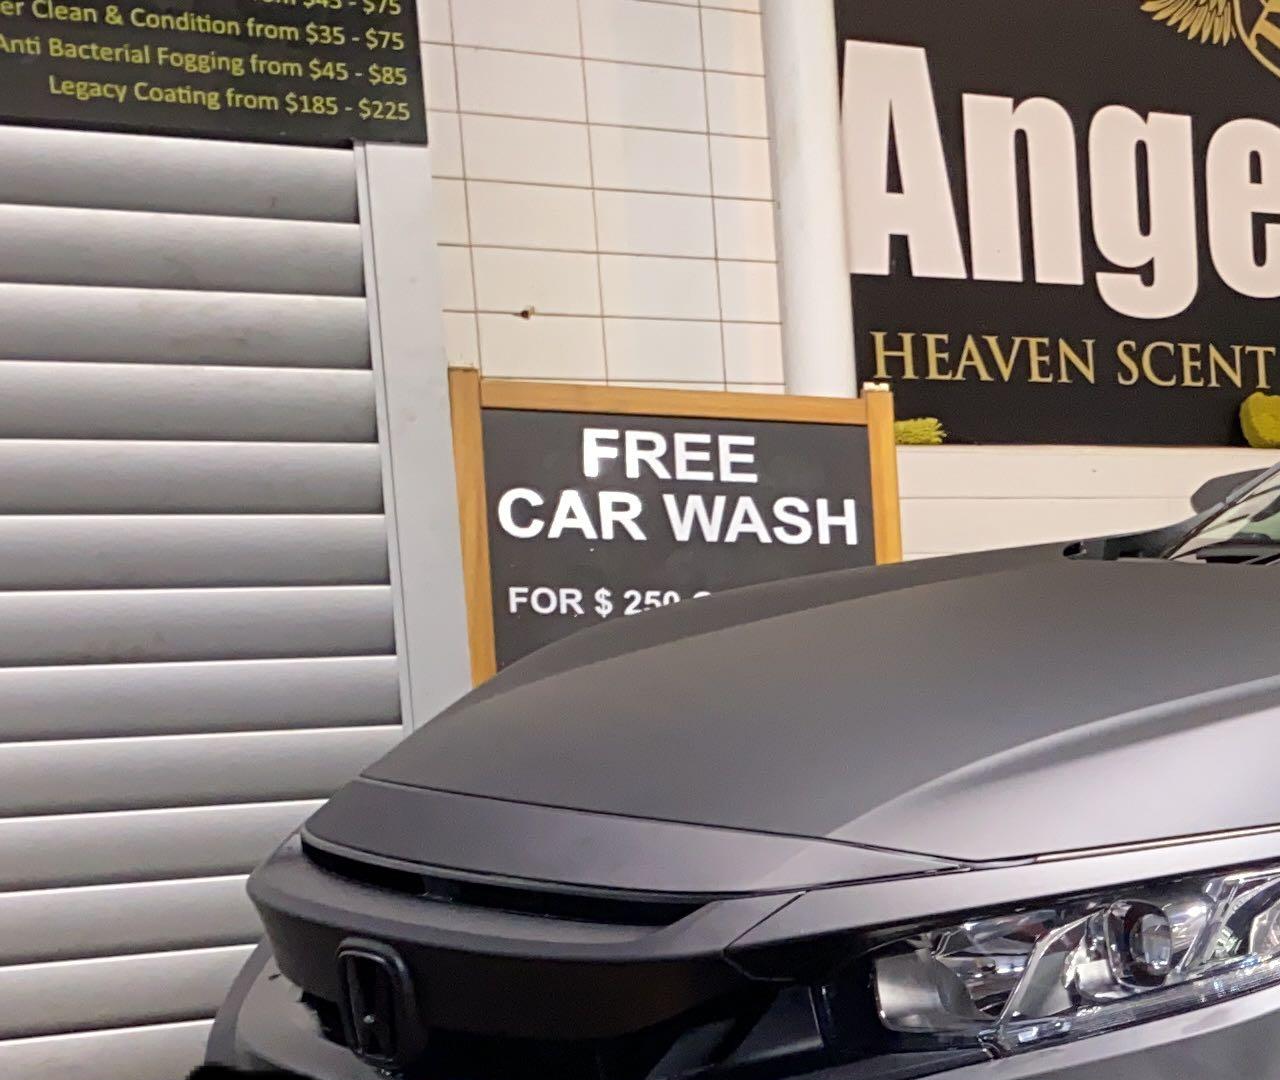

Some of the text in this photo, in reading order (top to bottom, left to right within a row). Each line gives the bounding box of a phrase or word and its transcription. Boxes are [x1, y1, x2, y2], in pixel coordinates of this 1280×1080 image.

[32, 0, 98, 23] Clean
[105, 5, 125, 25] &
[130, 8, 241, 36] Condition
[247, 17, 300, 41] from
[305, 22, 346, 46] $35
[365, 27, 405, 50] $75
[0, 33, 41, 55] Anti
[48, 37, 151, 65] Bacterial
[157, 47, 245, 77] Fogging
[250, 54, 303, 77] from
[309, 57, 349, 82] $45
[368, 63, 408, 86] $85
[48, 75, 127, 102] Legacy
[134, 81, 221, 111] Coating
[226, 88, 279, 111] from
[285, 91, 339, 115] $185
[358, 97, 411, 121] $225
[868, 331, 1098, 386] HEAVEN
[1116, 340, 1277, 390] SCENT
[582, 427, 759, 484] FREE
[498, 487, 858, 546] CAR WASH
[508, 586, 585, 615] FOR
[594, 586, 614, 618] $
